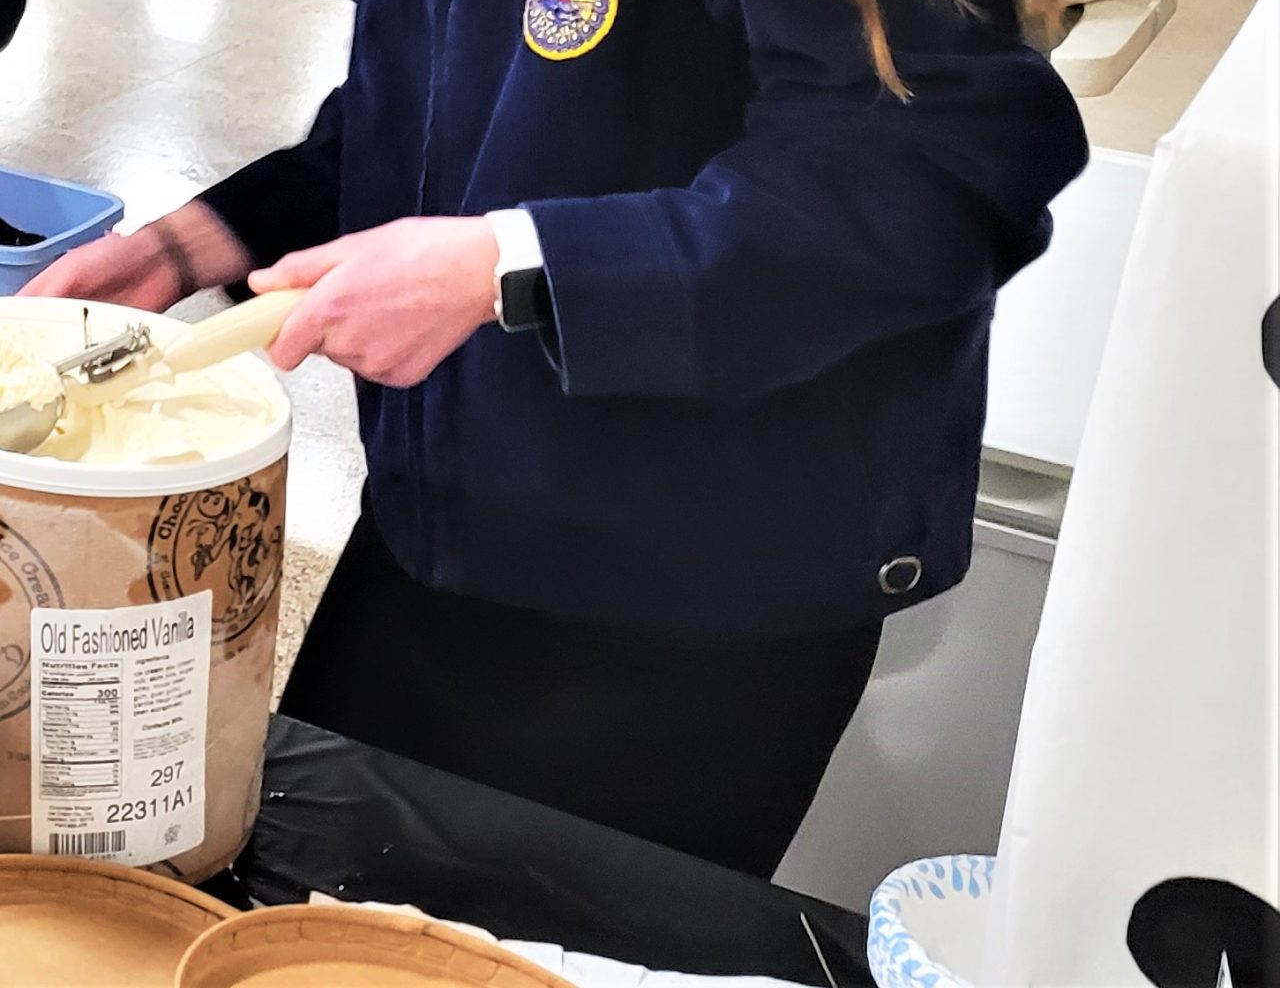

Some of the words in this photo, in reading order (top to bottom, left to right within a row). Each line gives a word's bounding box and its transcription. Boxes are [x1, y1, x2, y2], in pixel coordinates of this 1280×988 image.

[22, 561, 52, 609] Crea
[41, 623, 67, 654] Old
[72, 620, 148, 654] Fashioned
[152, 611, 195, 647] Vanilla
[97, 689, 118, 698] 300
[150, 761, 185, 787] 297
[106, 785, 193, 824] 22311A1
